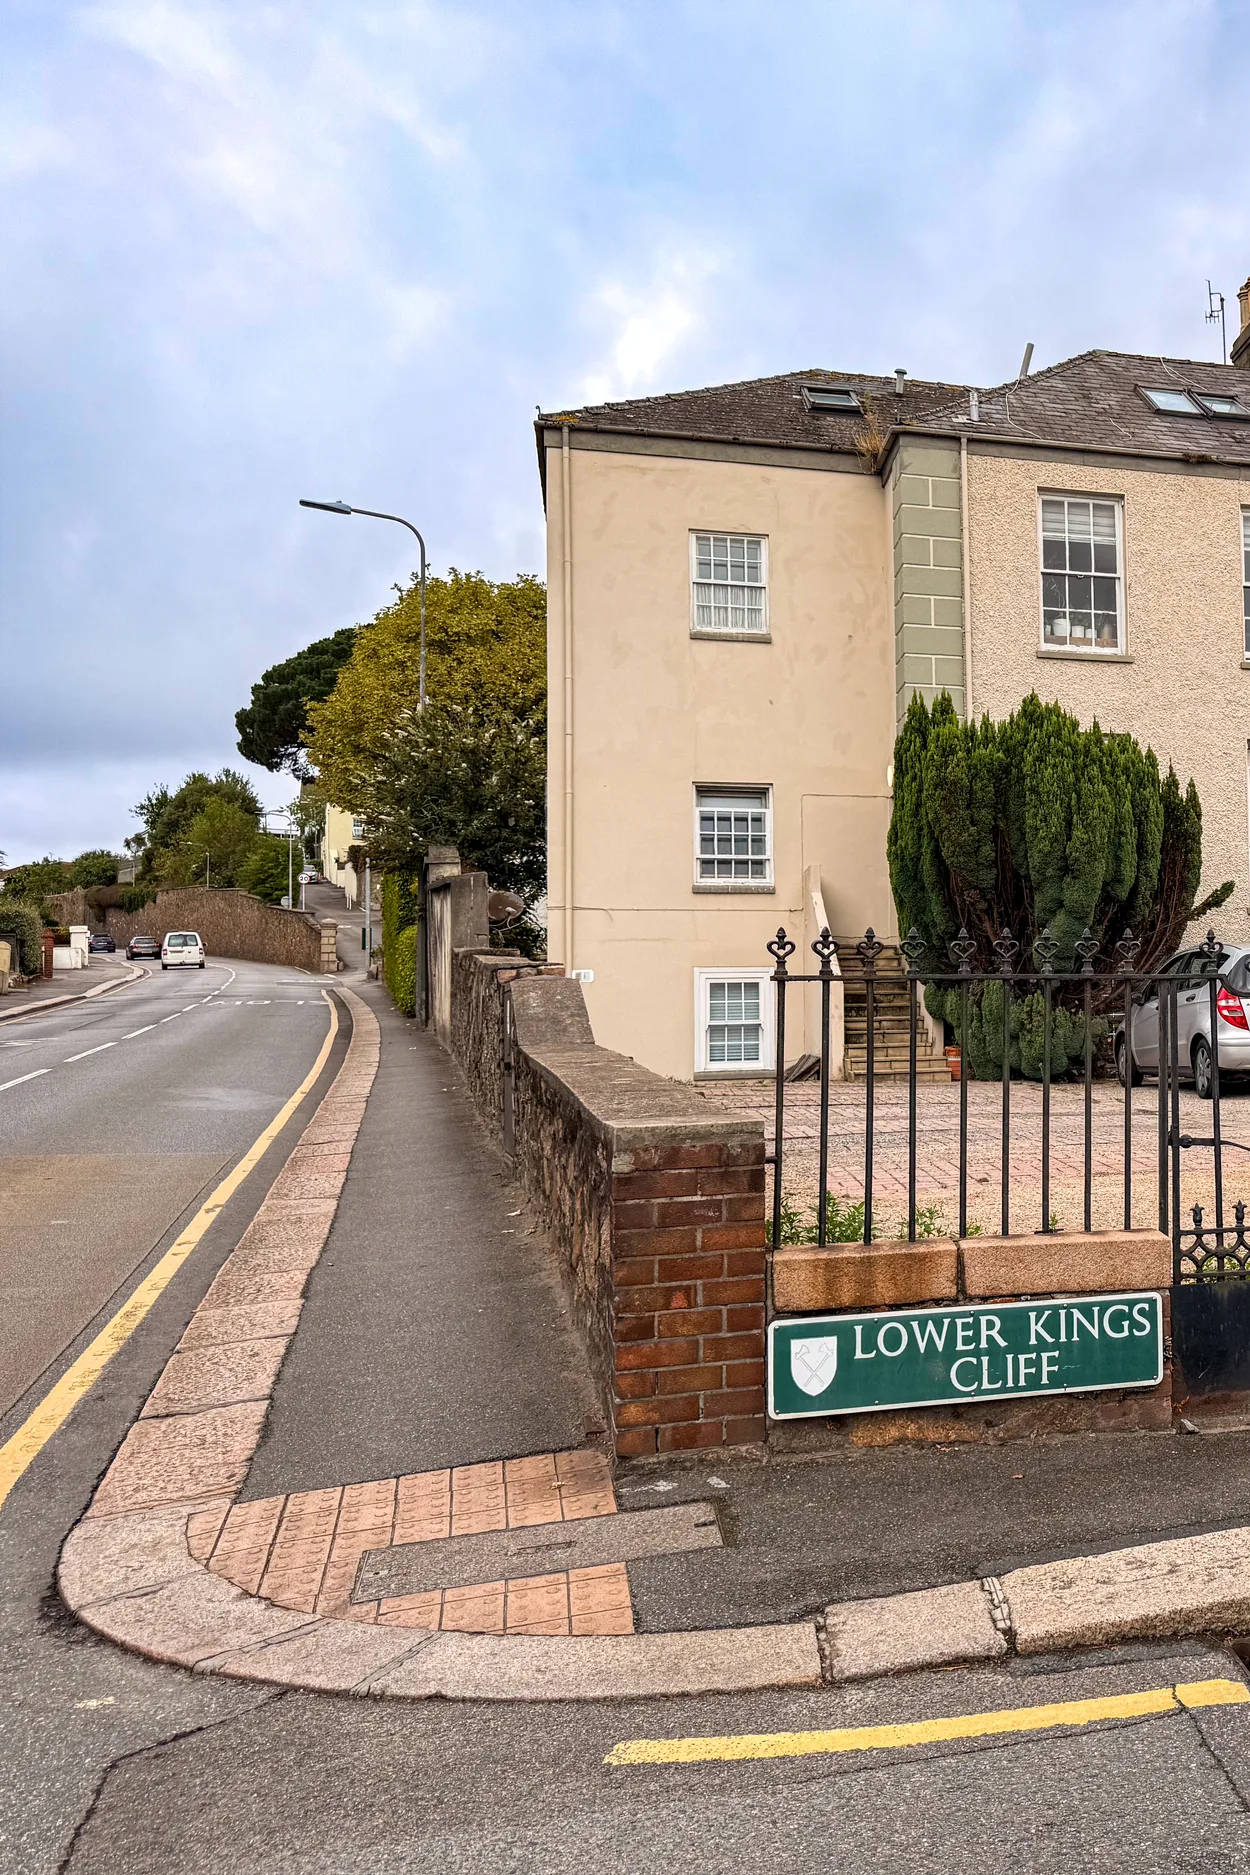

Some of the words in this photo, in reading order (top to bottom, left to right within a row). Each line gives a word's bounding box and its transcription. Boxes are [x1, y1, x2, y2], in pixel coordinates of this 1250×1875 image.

[854, 1315, 1008, 1360] LOWER
[1028, 1302, 1152, 1345] KINGS
[949, 1350, 1060, 1392] CLIFF
